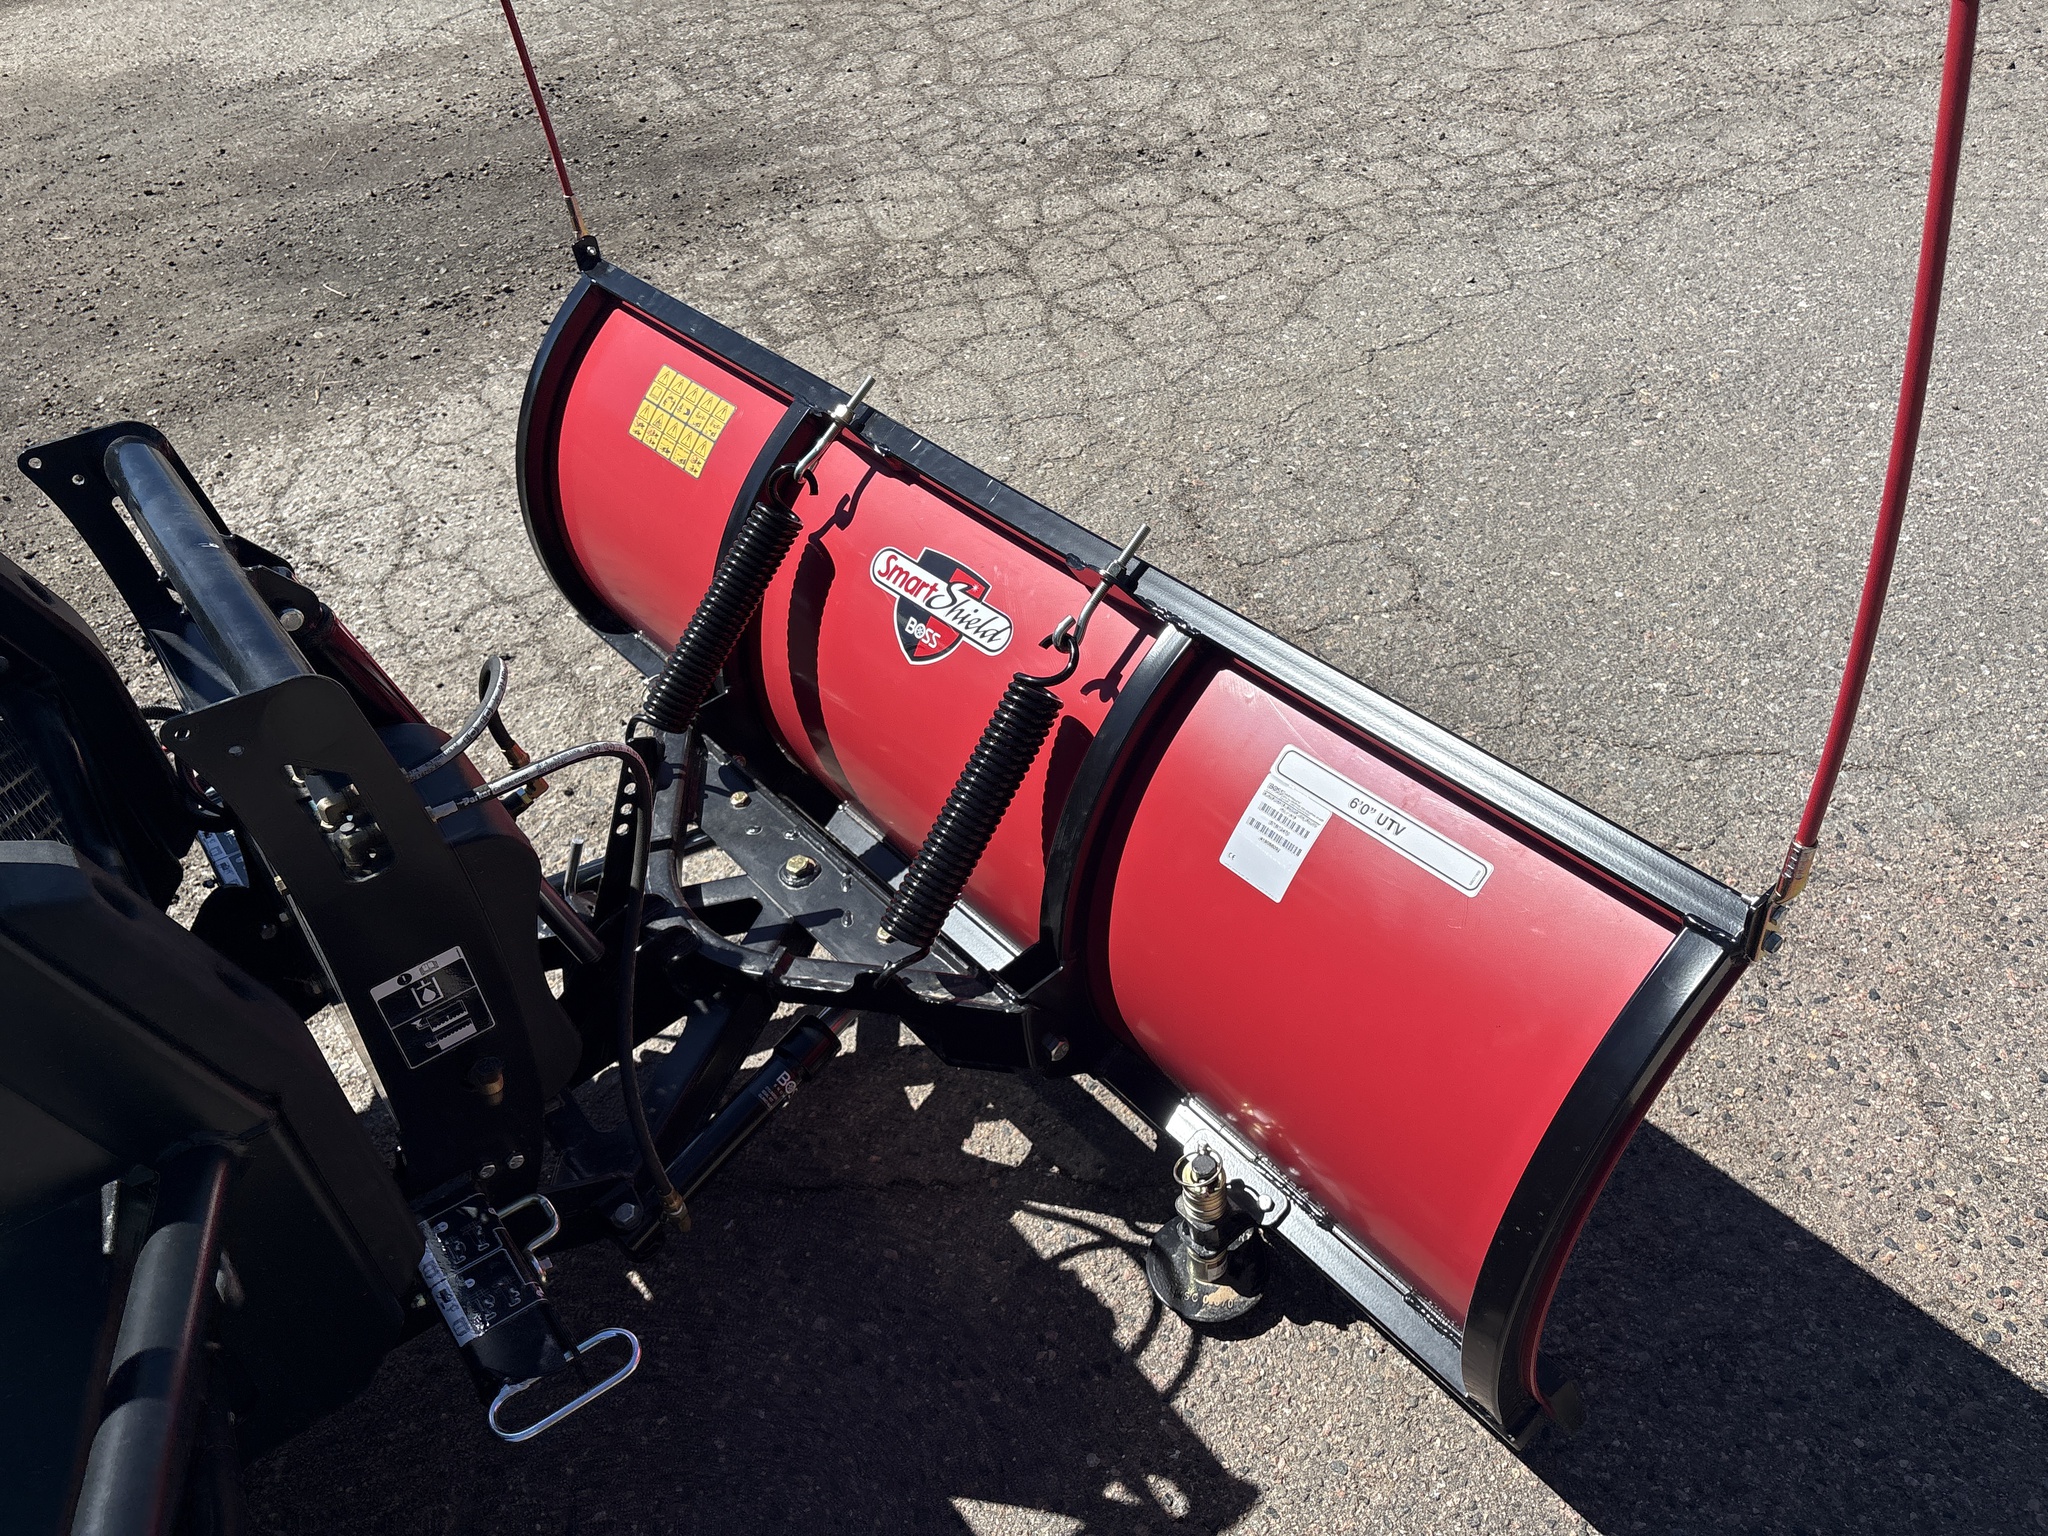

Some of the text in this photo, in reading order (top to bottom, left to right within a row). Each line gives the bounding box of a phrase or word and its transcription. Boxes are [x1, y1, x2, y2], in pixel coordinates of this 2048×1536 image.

[904, 616, 941, 649] BOSS
[461, 789, 491, 806] Parker
[1376, 812, 1407, 836] UTV
